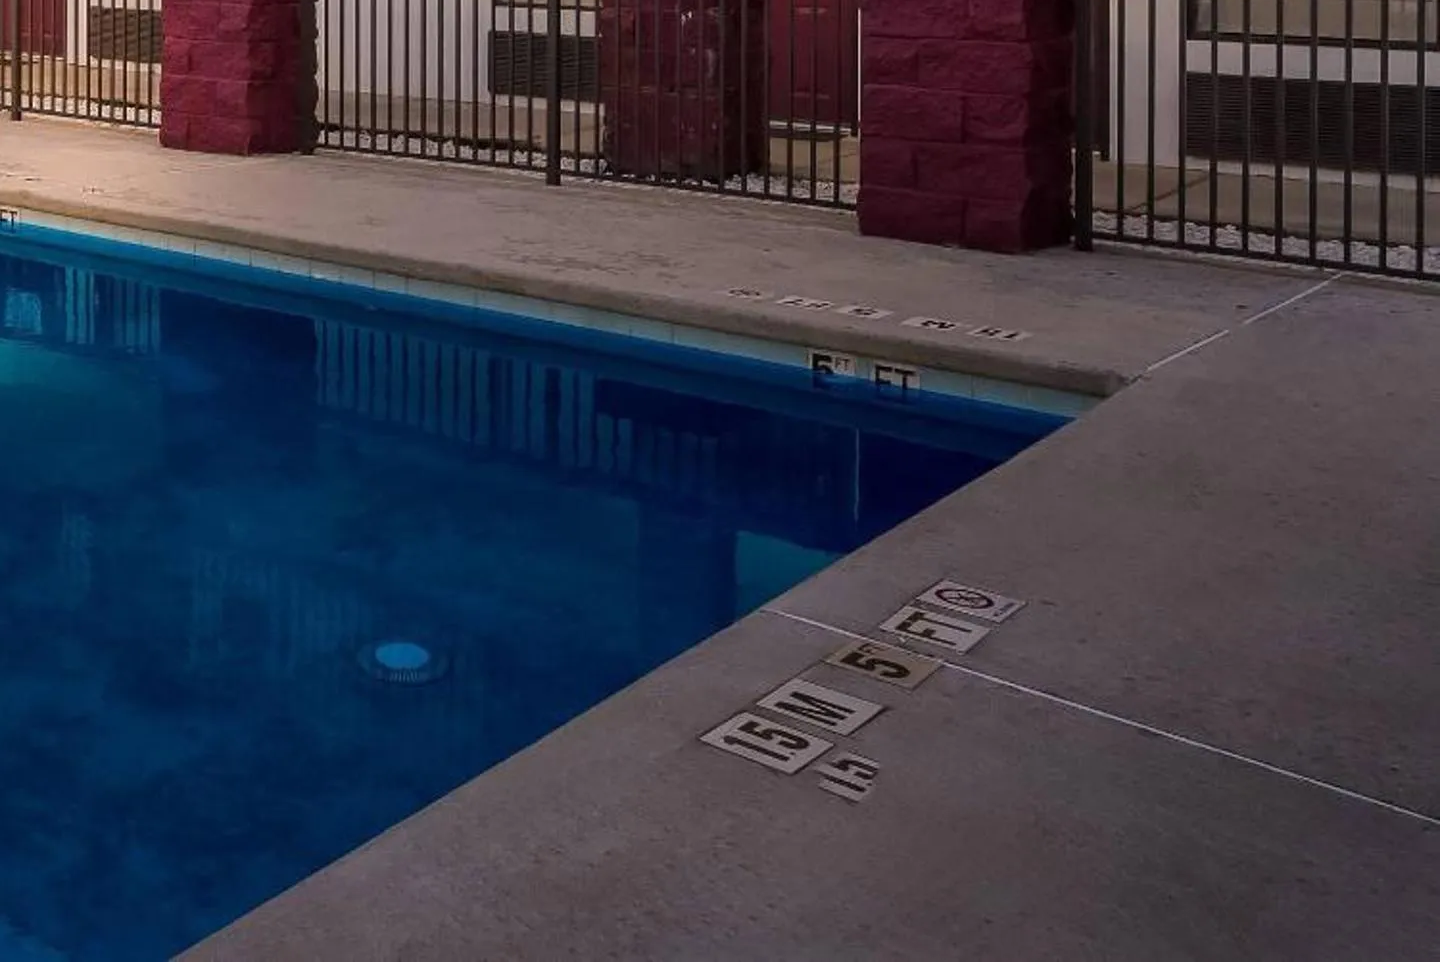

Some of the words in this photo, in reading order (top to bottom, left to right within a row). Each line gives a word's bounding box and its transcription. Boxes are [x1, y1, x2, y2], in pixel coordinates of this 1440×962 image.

[876, 365, 916, 390] FT
[773, 691, 857, 726] M
[840, 651, 910, 679] 5
[895, 610, 973, 646] FT
